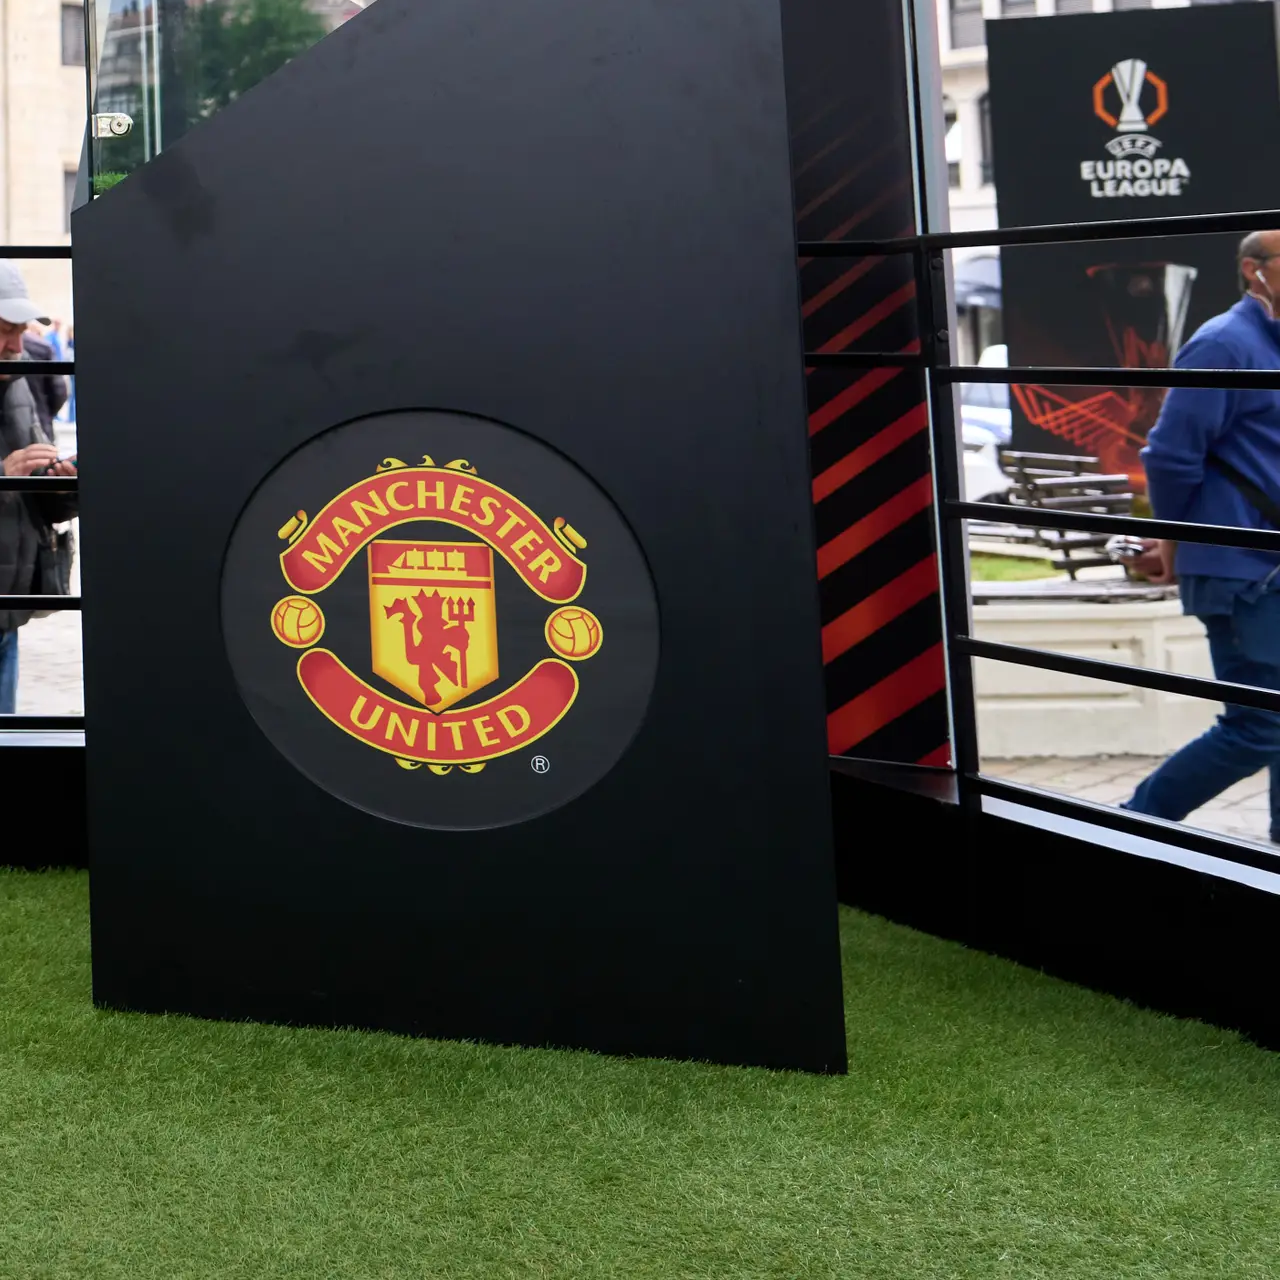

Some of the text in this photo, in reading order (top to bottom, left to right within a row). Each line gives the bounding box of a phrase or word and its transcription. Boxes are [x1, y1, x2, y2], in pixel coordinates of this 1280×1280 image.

[1080, 158, 1191, 181] EUROPA
[1091, 178, 1182, 198] LEAGUE
[301, 480, 562, 584] MANCHESTER
[350, 695, 531, 751] UNITED
